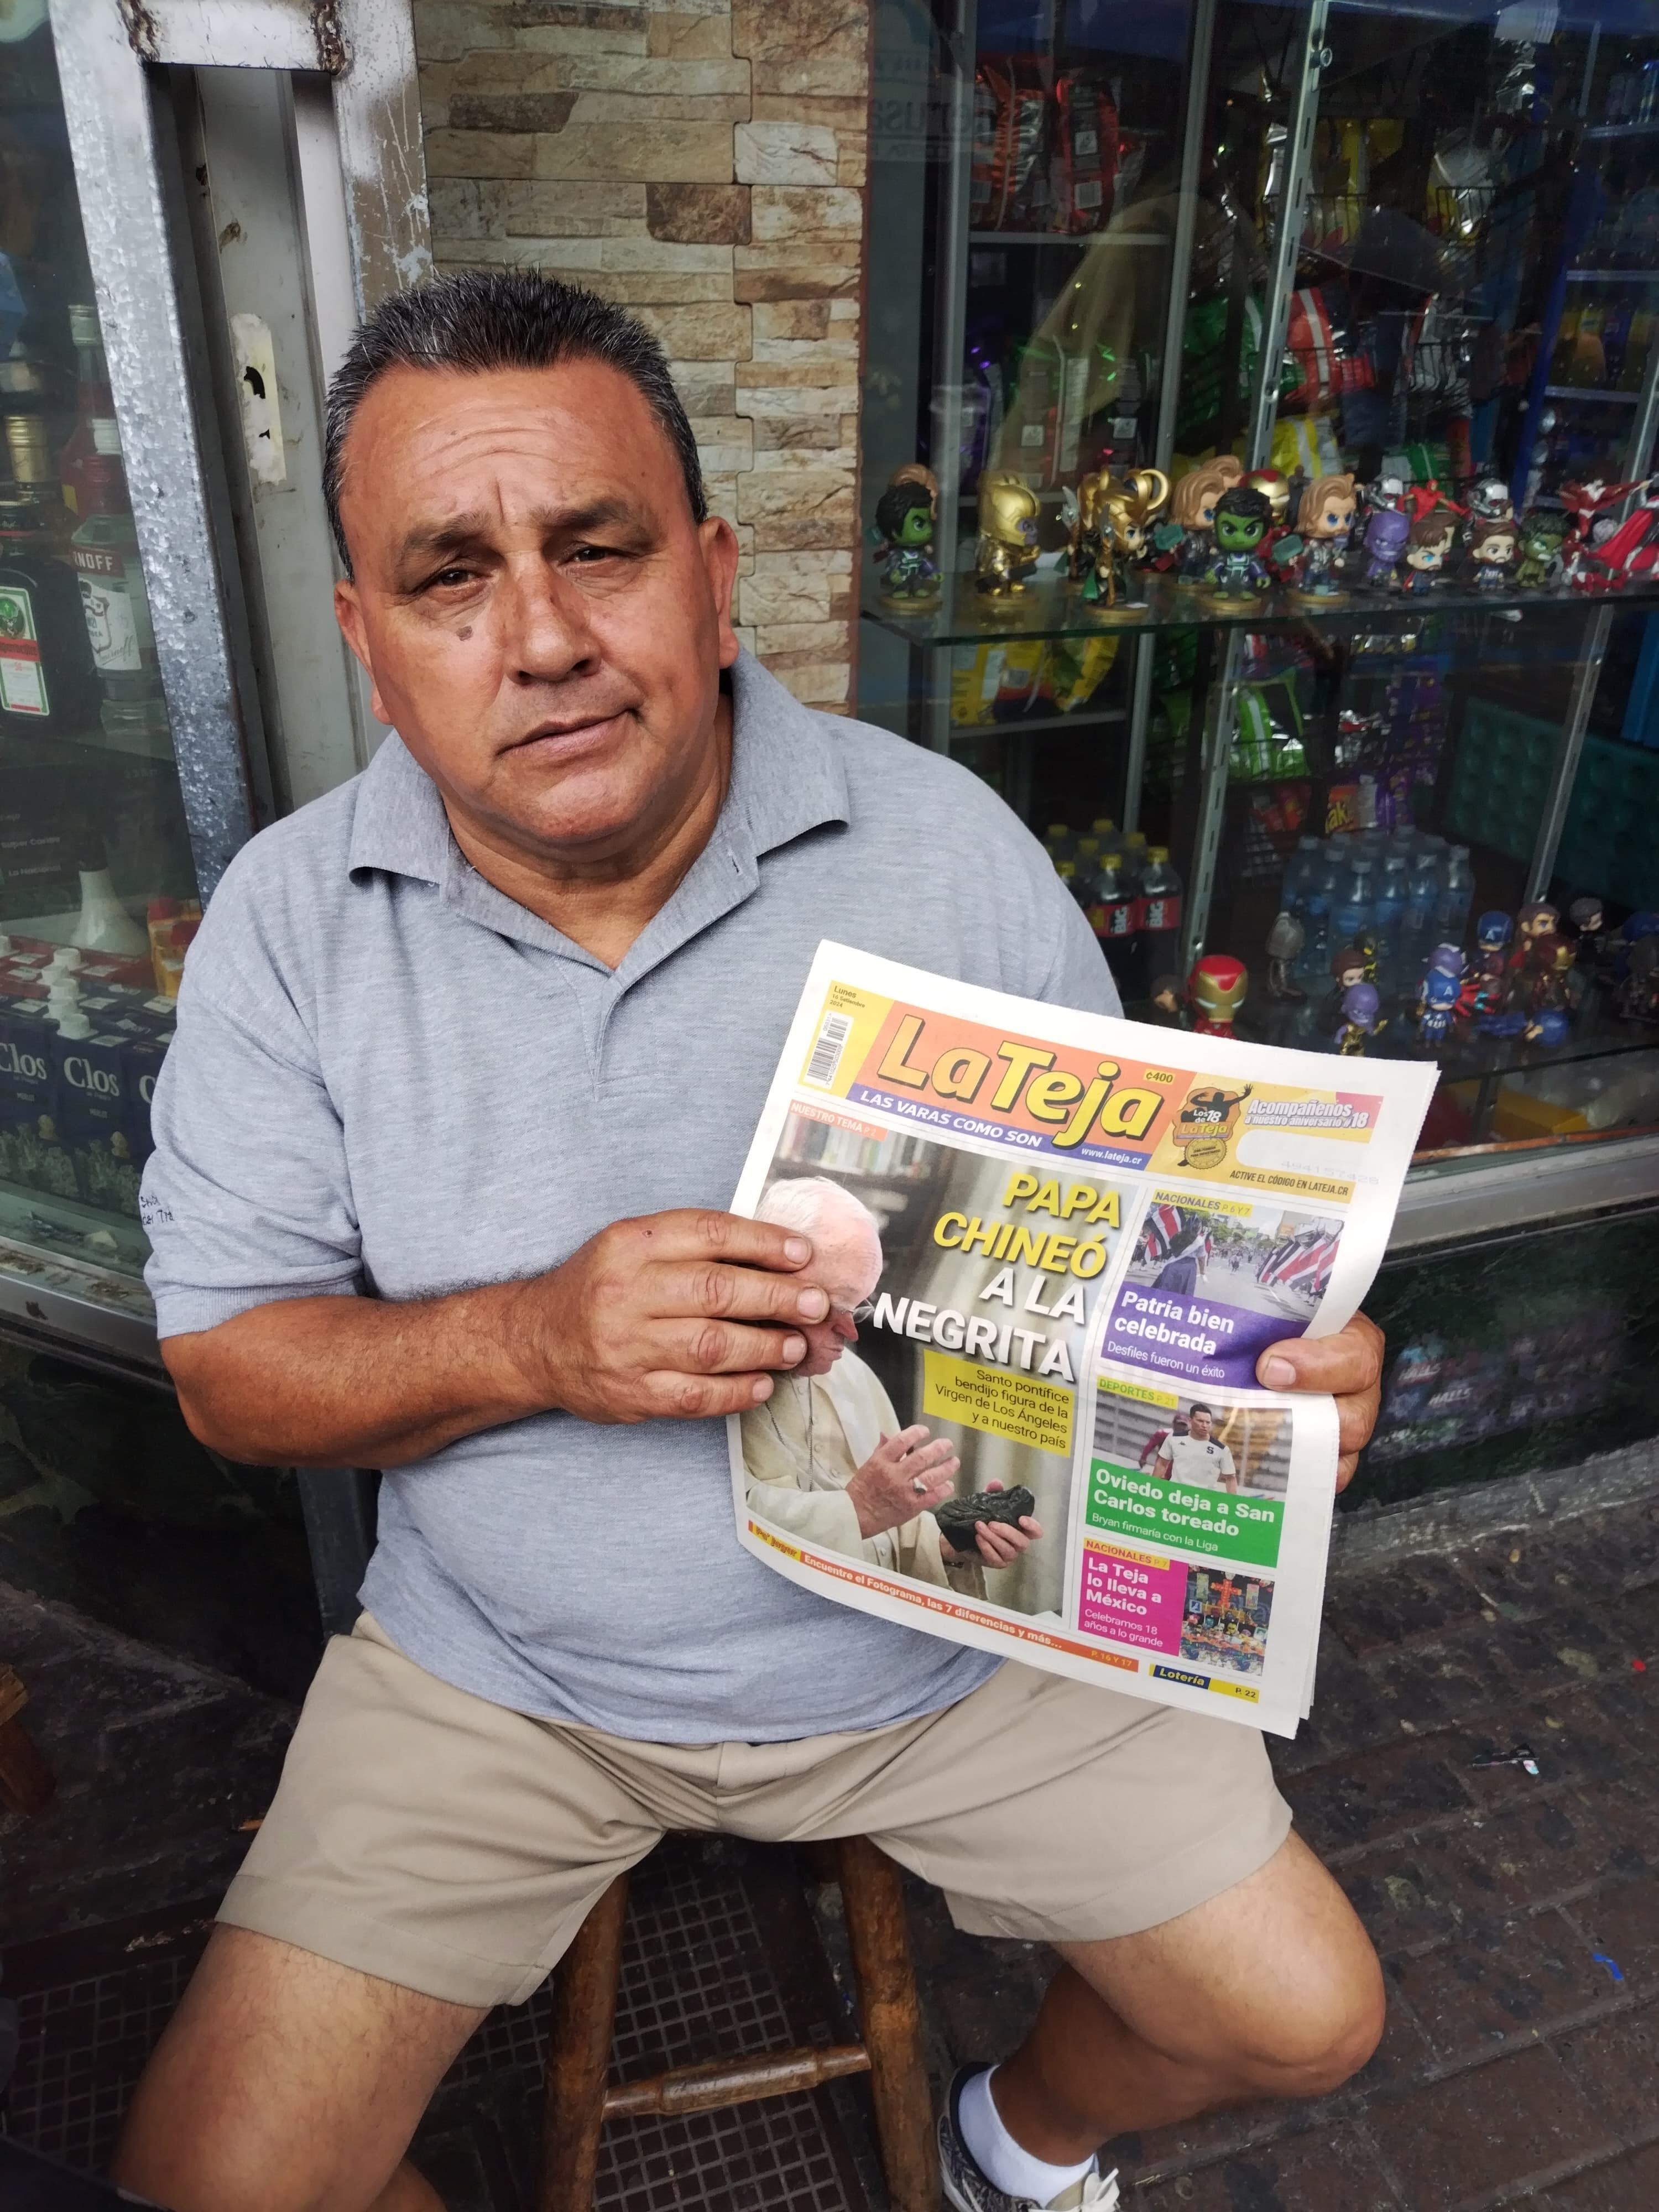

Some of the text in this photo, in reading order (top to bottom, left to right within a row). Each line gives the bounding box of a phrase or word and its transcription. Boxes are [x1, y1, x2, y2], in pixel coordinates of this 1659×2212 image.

[834, 985, 857, 998] Lunes
[64, 1057, 120, 1097] Clos
[790, 1102, 836, 1124] NUESTRO
[836, 1113, 863, 1133] TEMA
[860, 1090, 1044, 1148] LAS VARAS COMO SON
[1193, 1109, 1222, 1123] Los 18
[1244, 1115, 1252, 1124] a
[1252, 1114, 1288, 1126] nuestro
[1289, 1115, 1343, 1128] aniversario
[1247, 1099, 1353, 1118] Acompañenos
[1081, 1147, 1142, 1165] www.lateja.cr
[1002, 1171, 1121, 1229] PAPA
[1229, 1170, 1349, 1197] ACTIVE EL CÓDIGO EN LATEJA.CR
[1154, 1191, 1221, 1210] NACIONALES
[933, 1211, 1109, 1279] CHINEÓ
[978, 1266, 1086, 1324] A LA
[1120, 1290, 1234, 1334] Patria bien
[873, 1291, 1075, 1383] NEGRITA
[1114, 1317, 1217, 1355] celebrada
[1107, 1340, 1225, 1379] Desfiles fueron un éxito
[955, 1376, 1068, 1419] bendijo figura de la
[976, 1369, 1070, 1404] Santo pontífice
[1099, 1378, 1155, 1401] DEPORTES
[935, 1383, 1068, 1434] Virgen de Los Ángeles
[971, 1412, 1066, 1449] y a nuestro país
[1095, 1468, 1275, 1522] Oviedo deja a San
[1094, 1489, 1240, 1536] Carlos toreado
[1092, 1512, 1219, 1552] Bryan firmaría con la Liga
[1086, 1540, 1152, 1564] NACIONALES
[1088, 1557, 1149, 1584] La Teja
[804, 1554, 853, 1580] Encuentre
[855, 1574, 865, 1585] el
[867, 1578, 925, 1607] Fotograma,
[927, 1597, 943, 1611] las
[945, 1604, 952, 1613] 7
[954, 1607, 1016, 1635] diferencias
[1017, 1629, 1025, 1639] y
[1086, 1588, 1147, 1615] México
[1087, 1572, 1162, 1603] lo lleva a
[1084, 1608, 1158, 1635] Celebramos 18
[1084, 1620, 1108, 1633] años
[1118, 1628, 1128, 1639] lo
[1129, 1633, 1164, 1647] grande
[1159, 1667, 1205, 1686] Lotería
[1244, 1689, 1256, 1698] 22
